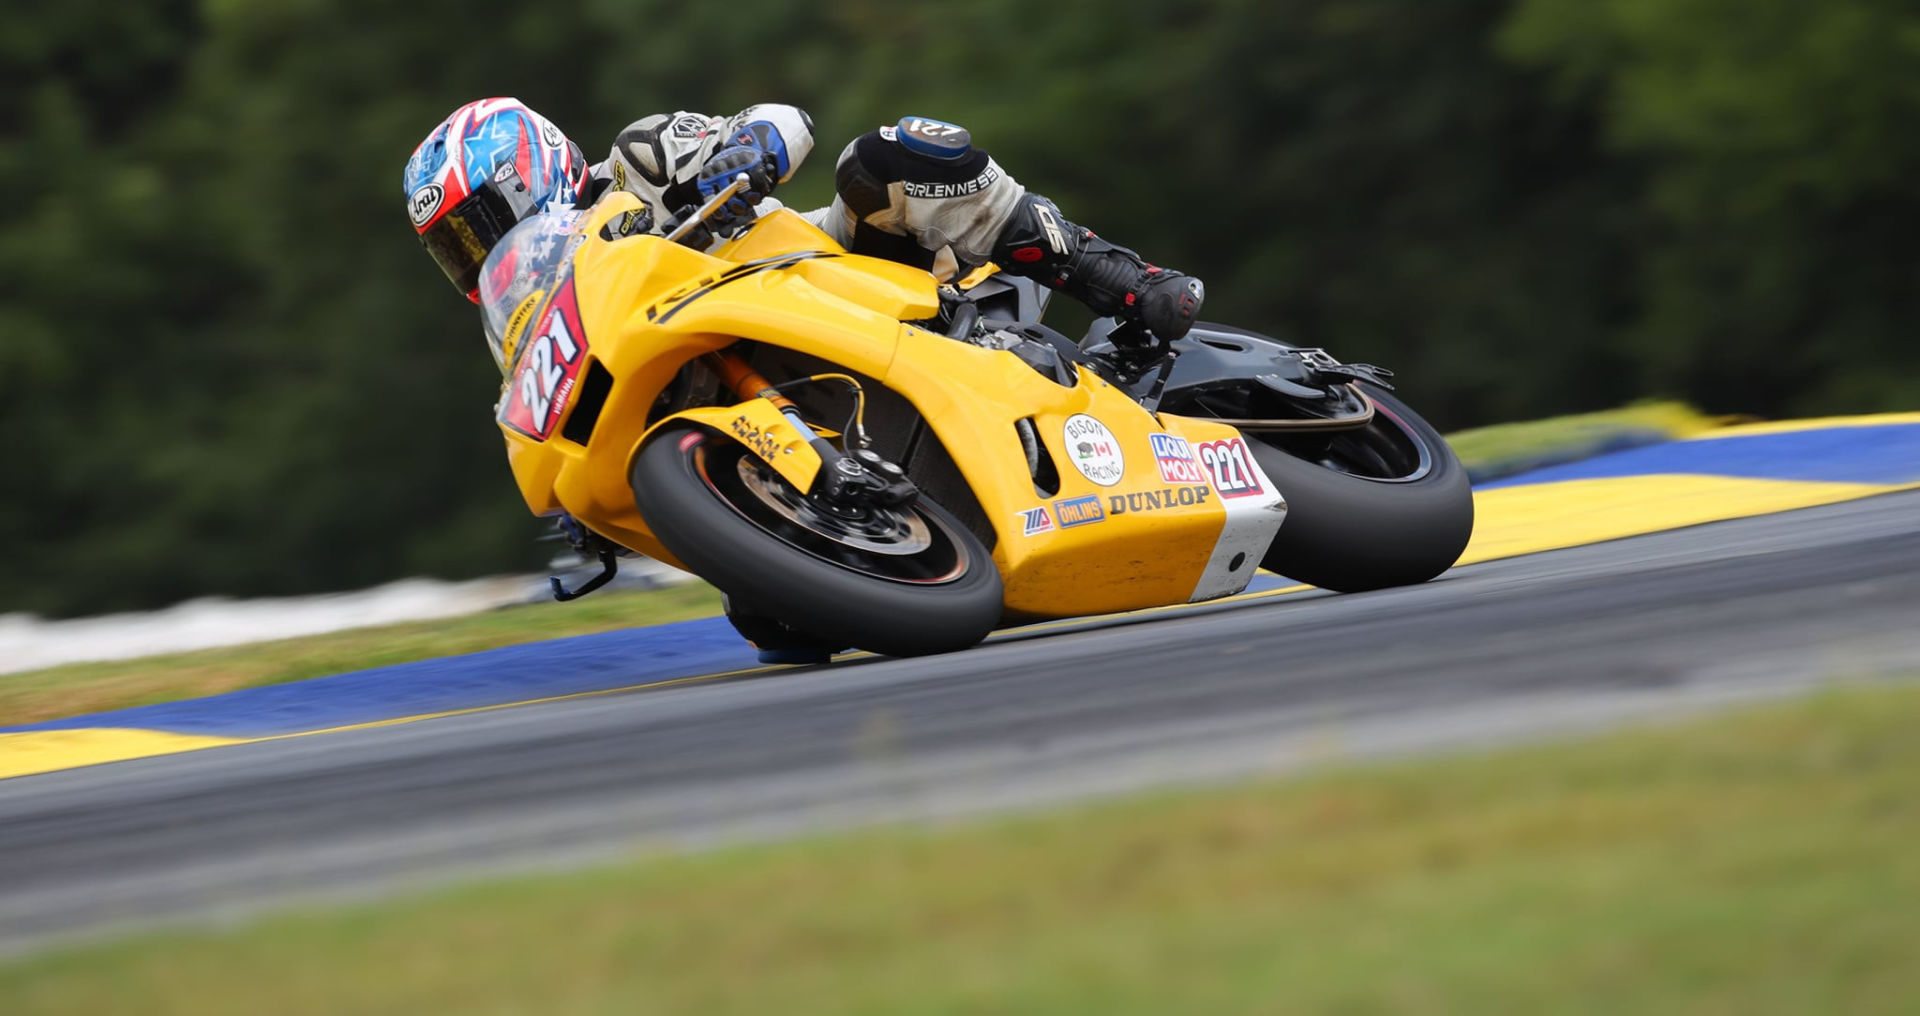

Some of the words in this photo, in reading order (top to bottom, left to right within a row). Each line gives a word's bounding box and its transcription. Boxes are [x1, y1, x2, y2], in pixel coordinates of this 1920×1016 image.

[412, 187, 438, 216] Arai
[521, 308, 579, 435] 221
[553, 378, 575, 415] YAMAHA
[1066, 419, 1104, 440] BISON
[1152, 436, 1192, 460] LIQUI
[1082, 461, 1120, 480] RACING
[1160, 459, 1201, 481] MOLY
[1201, 441, 1261, 495] 221
[1058, 502, 1101, 524] ÖHLINS
[1109, 486, 1210, 515] DUNLOP
